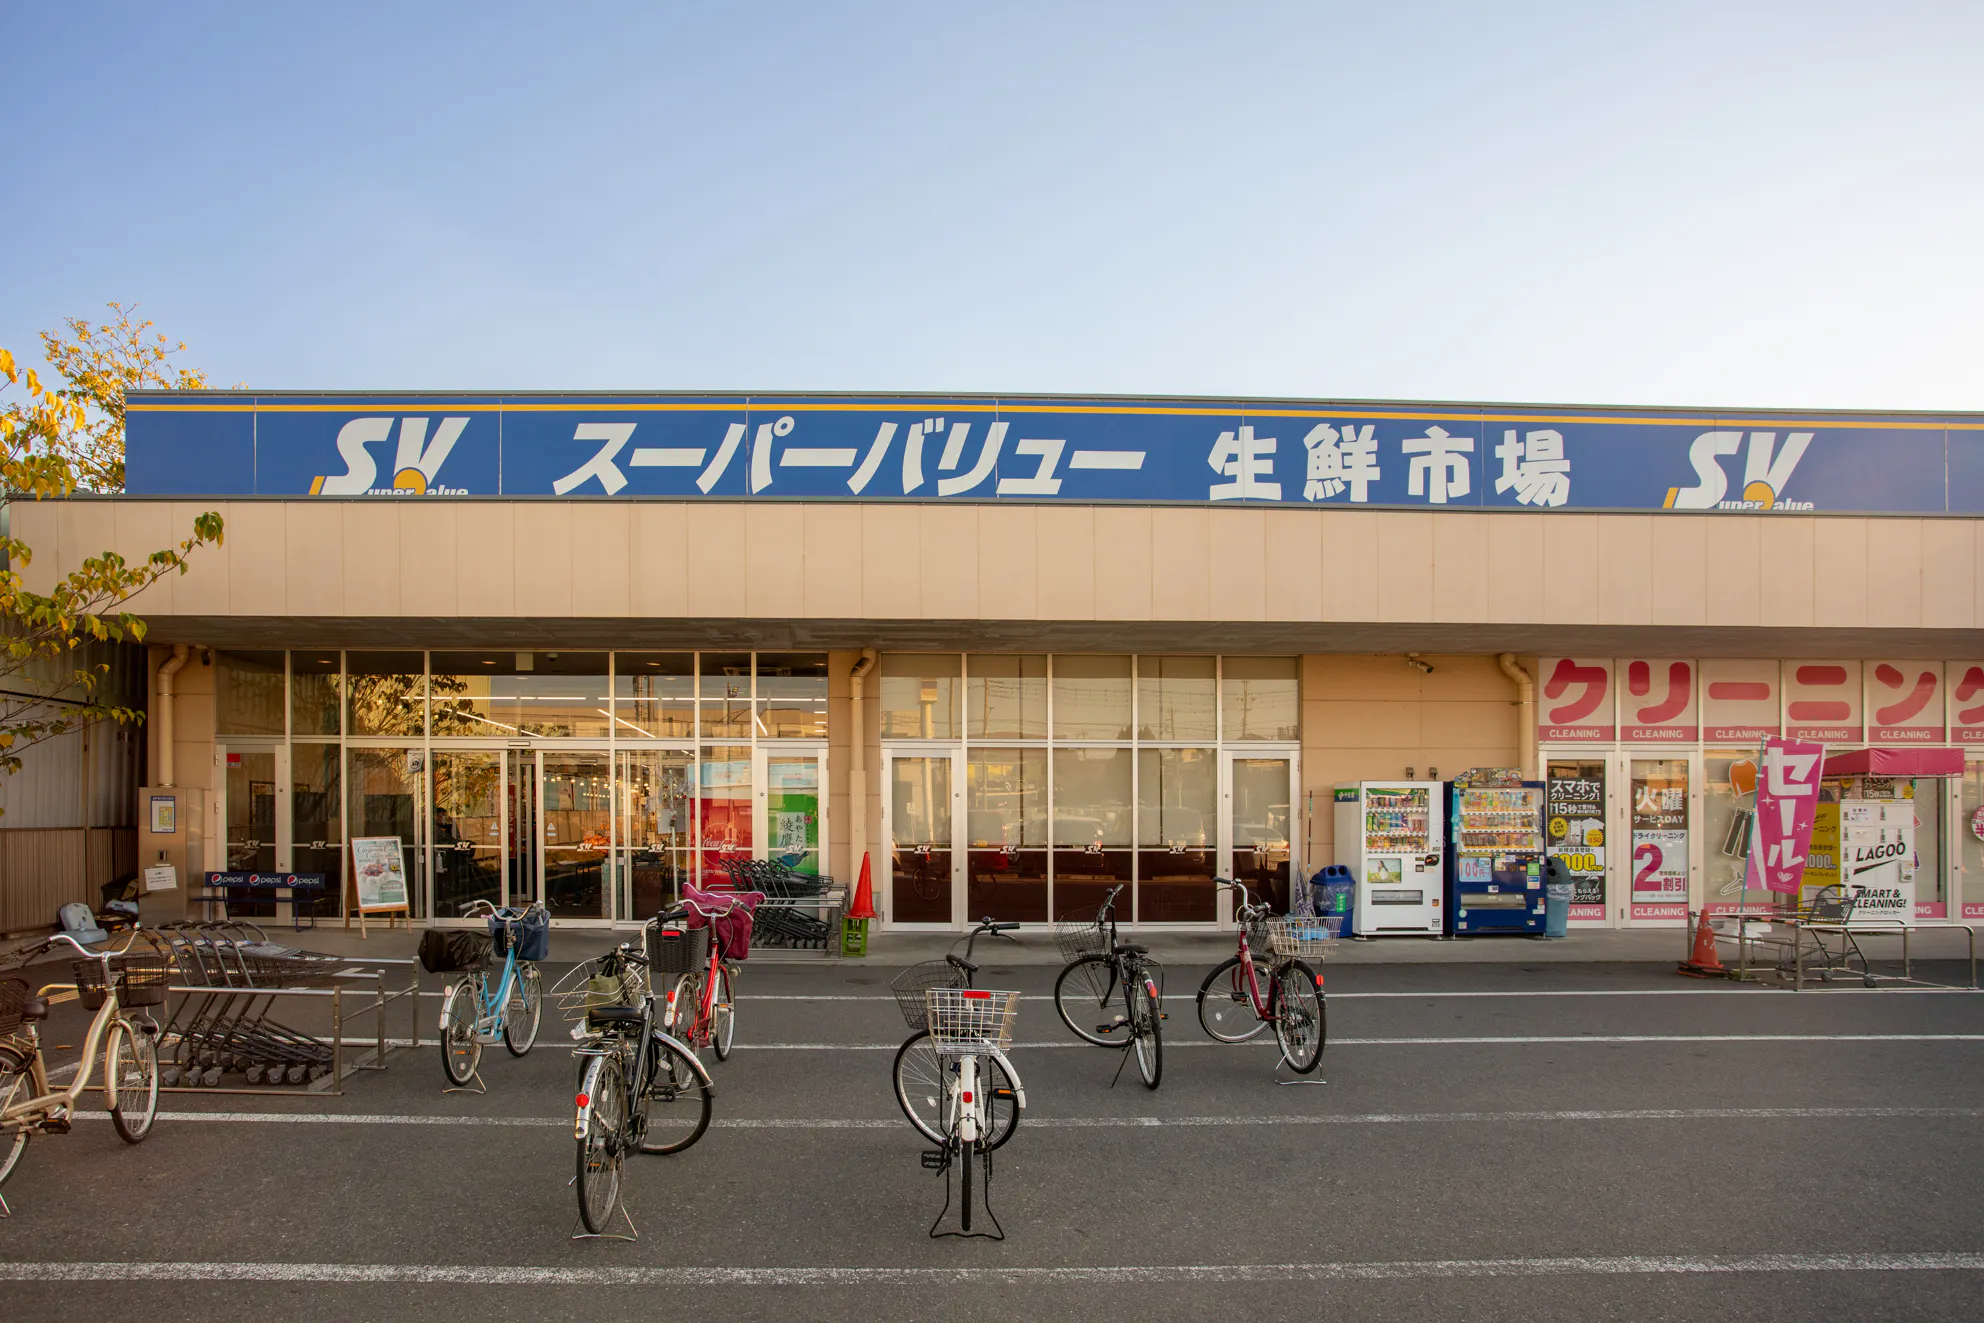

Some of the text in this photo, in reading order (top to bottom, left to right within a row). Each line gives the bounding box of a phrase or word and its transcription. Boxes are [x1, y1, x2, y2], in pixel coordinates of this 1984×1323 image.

[553, 415, 1571, 507] スーパーバリュー 生鮮市場
[1549, 729, 1601, 739] CLEANING
[1632, 729, 1684, 739] CLEANING
[1797, 730, 1849, 740] CLEANING
[1880, 730, 1931, 740] CLEANING
[1550, 779, 1601, 793] スマホで
[1635, 786, 1683, 811] 火曜
[1762, 747, 1821, 869] セール
[1633, 815, 1685, 823] サービスDAY
[1856, 842, 1906, 862] LAGOO
[222, 875, 244, 883] pepsi
[260, 876, 282, 884] pepsi
[1892, 889, 1901, 898] &
[1634, 907, 1685, 916] CLEANING
